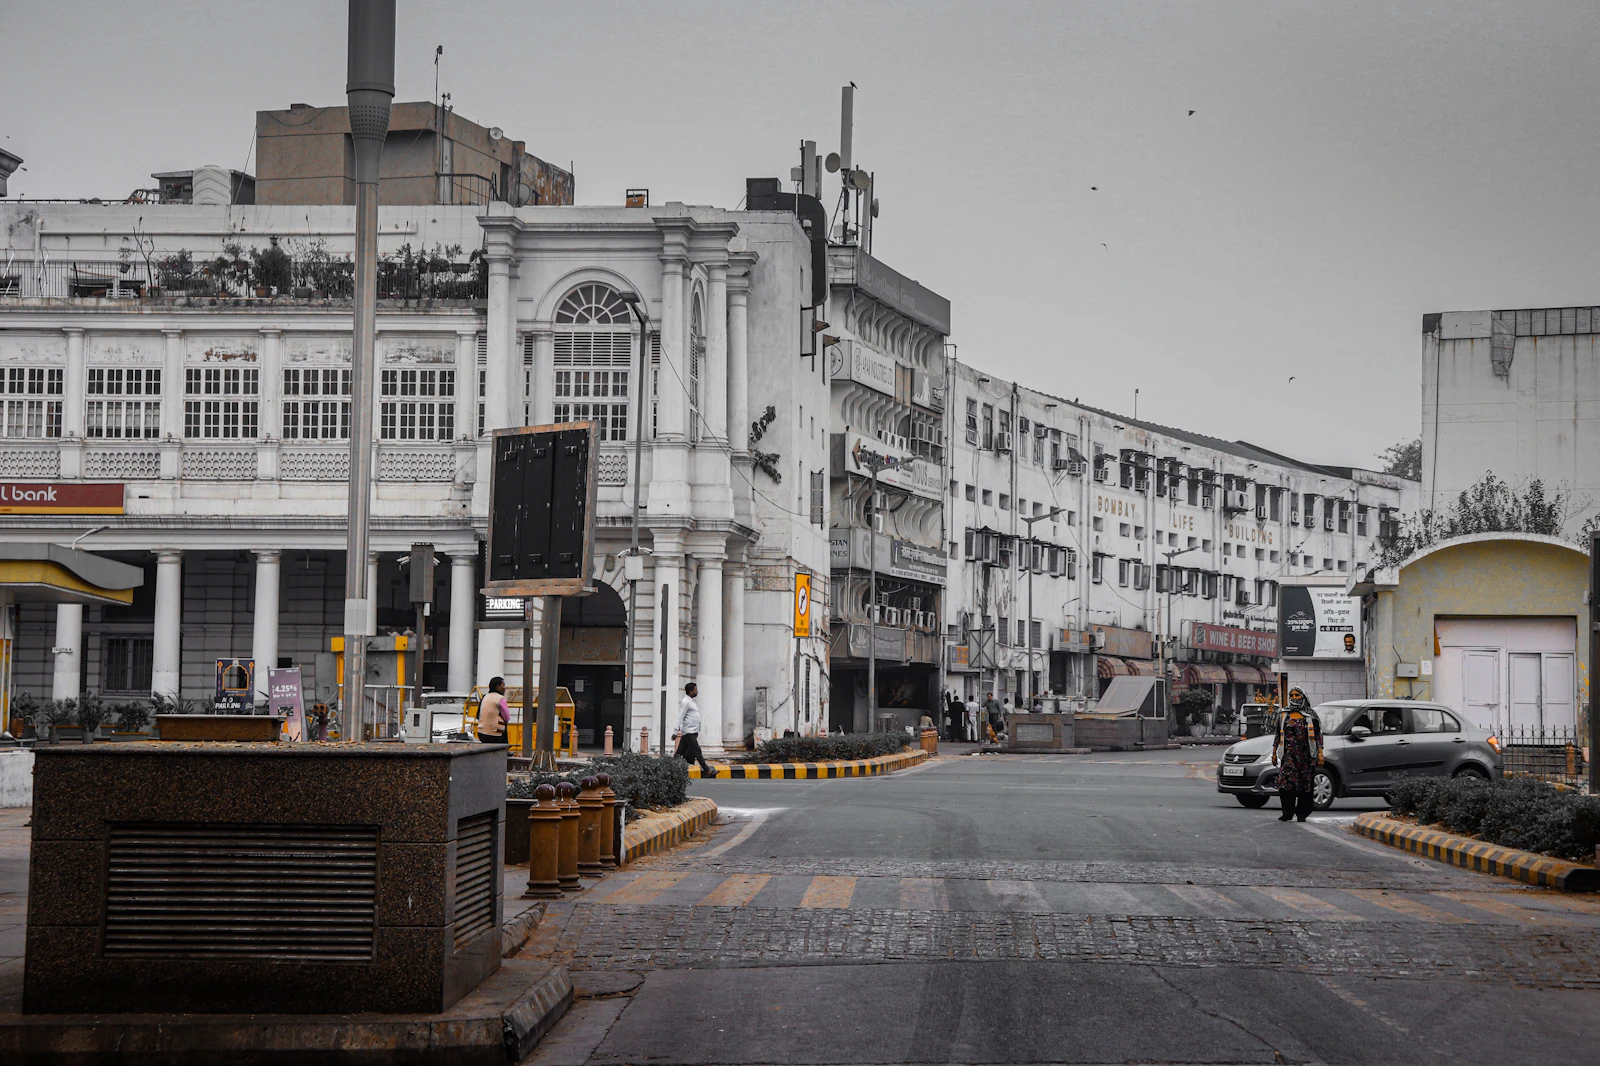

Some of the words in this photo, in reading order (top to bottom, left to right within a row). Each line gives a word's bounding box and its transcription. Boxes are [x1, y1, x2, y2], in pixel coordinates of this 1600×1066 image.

[12, 486, 57, 502] bank
[1098, 496, 1136, 518] BOMBAY
[1172, 513, 1194, 530] LIFE
[1229, 524, 1273, 544] BUILDING
[490, 598, 520, 609] PARKING
[1210, 630, 1228, 646] WINE
[1230, 634, 1236, 647] &
[1238, 635, 1256, 650] BEER
[1258, 637, 1276, 652] SHOP
